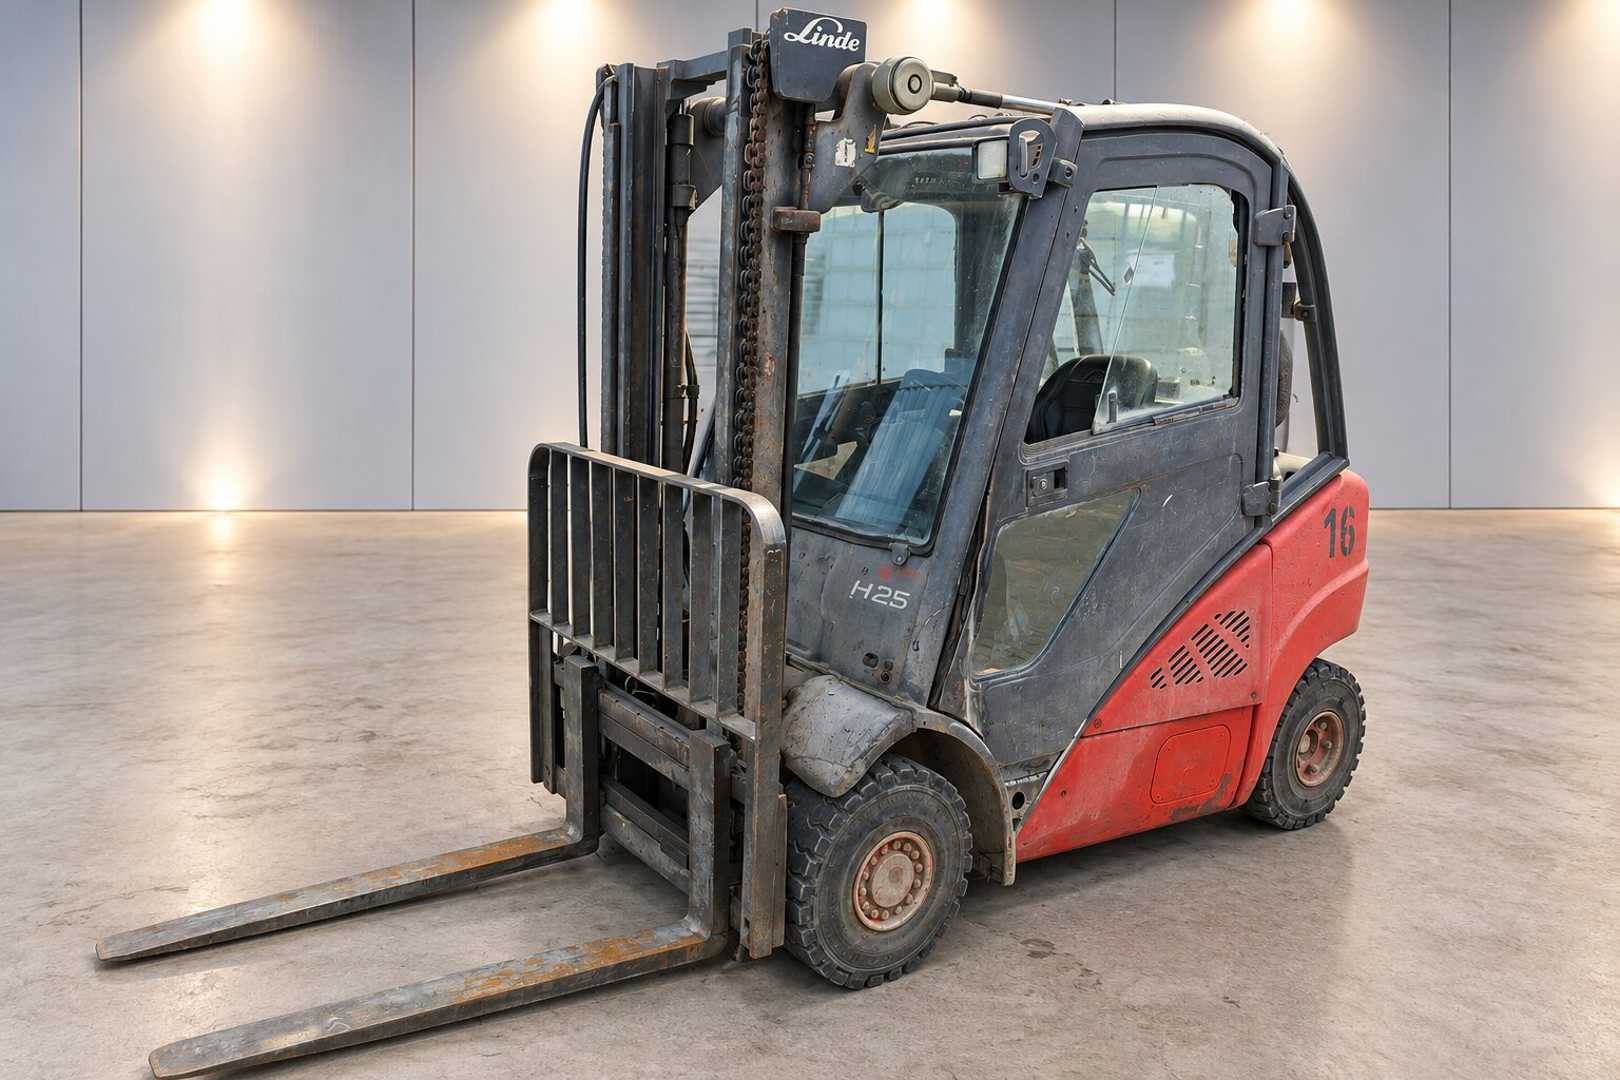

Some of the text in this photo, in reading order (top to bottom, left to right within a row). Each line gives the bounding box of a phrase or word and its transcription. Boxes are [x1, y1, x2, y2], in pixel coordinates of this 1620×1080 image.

[784, 17, 861, 52] Linde
[1323, 507, 1356, 559] 16
[849, 580, 911, 609] H25
